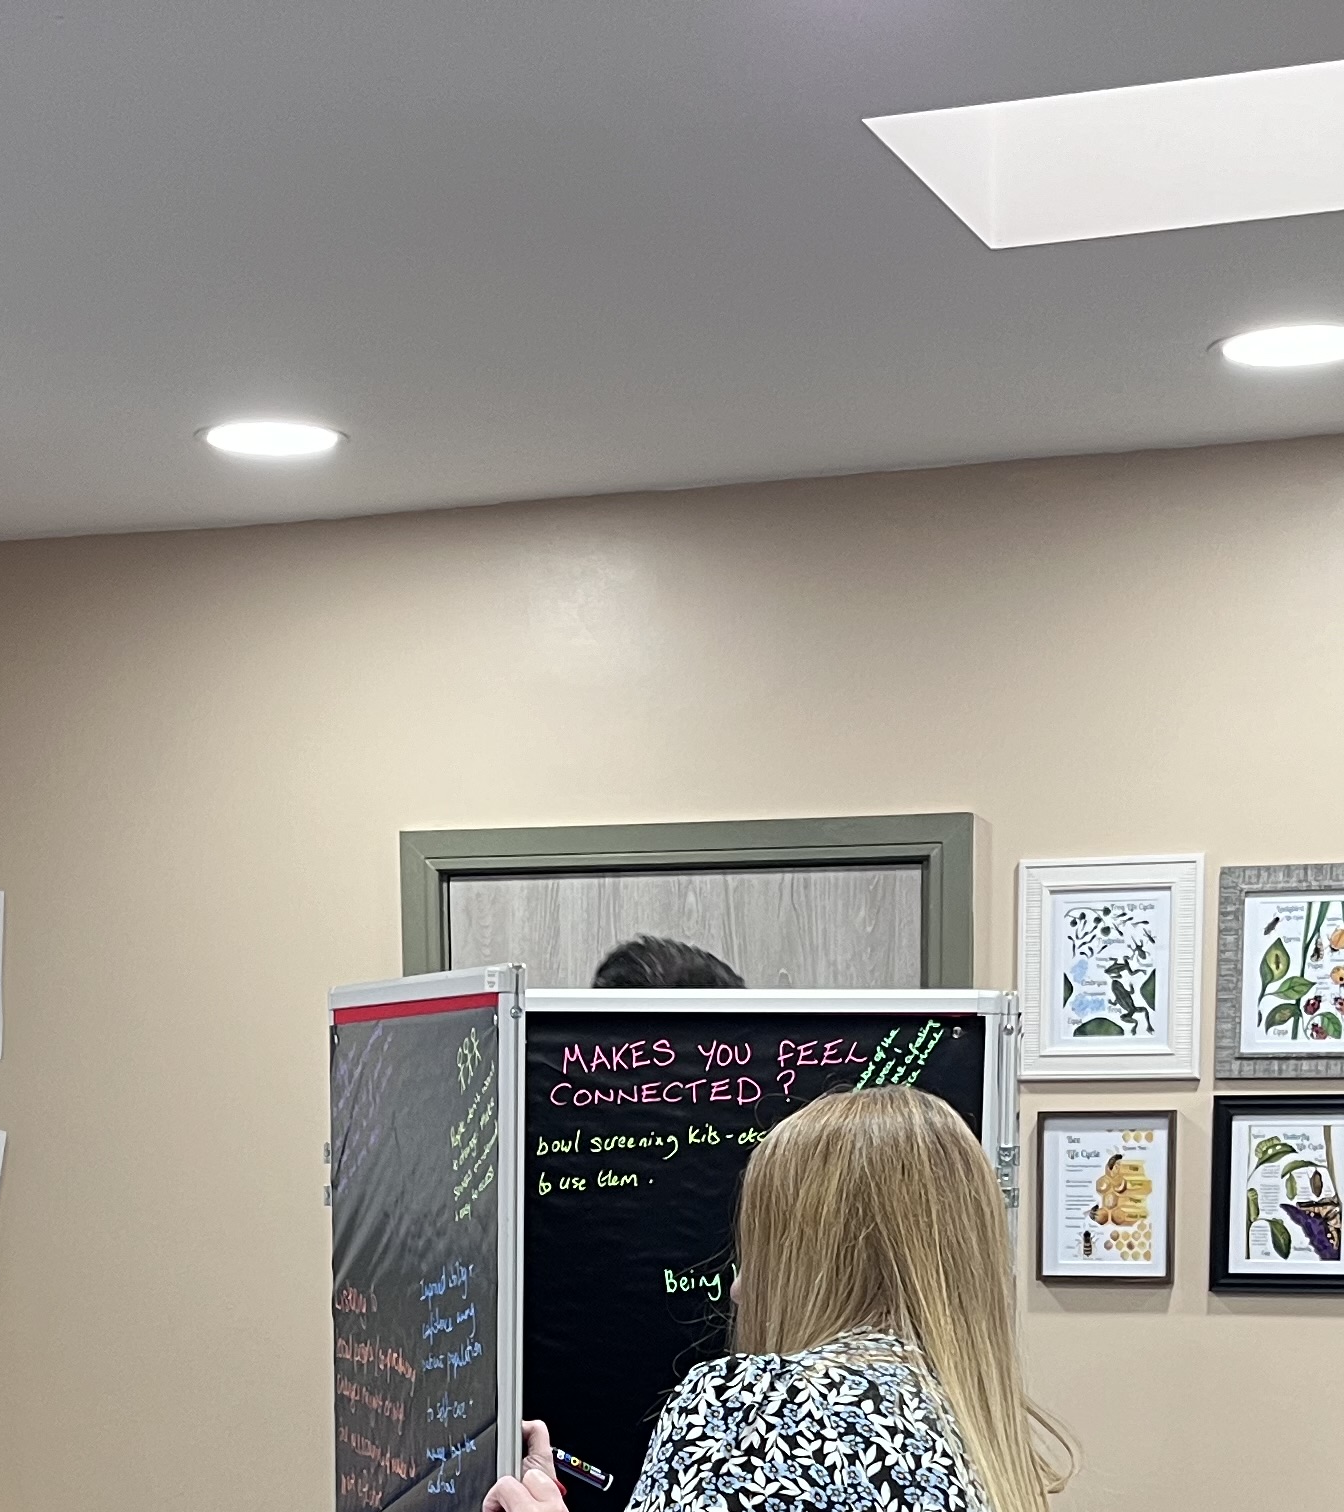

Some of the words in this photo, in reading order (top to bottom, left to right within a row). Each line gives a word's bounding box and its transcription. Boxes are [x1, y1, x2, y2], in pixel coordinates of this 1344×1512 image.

[562, 1039, 676, 1075] MAKES
[697, 1039, 752, 1071] YOU
[776, 1038, 868, 1068] FEEL
[550, 1076, 762, 1106] CONNECTED
[536, 1129, 581, 1156] bowl
[590, 1131, 679, 1160] screening
[559, 1175, 587, 1191] use
[664, 1269, 721, 1301] Being
